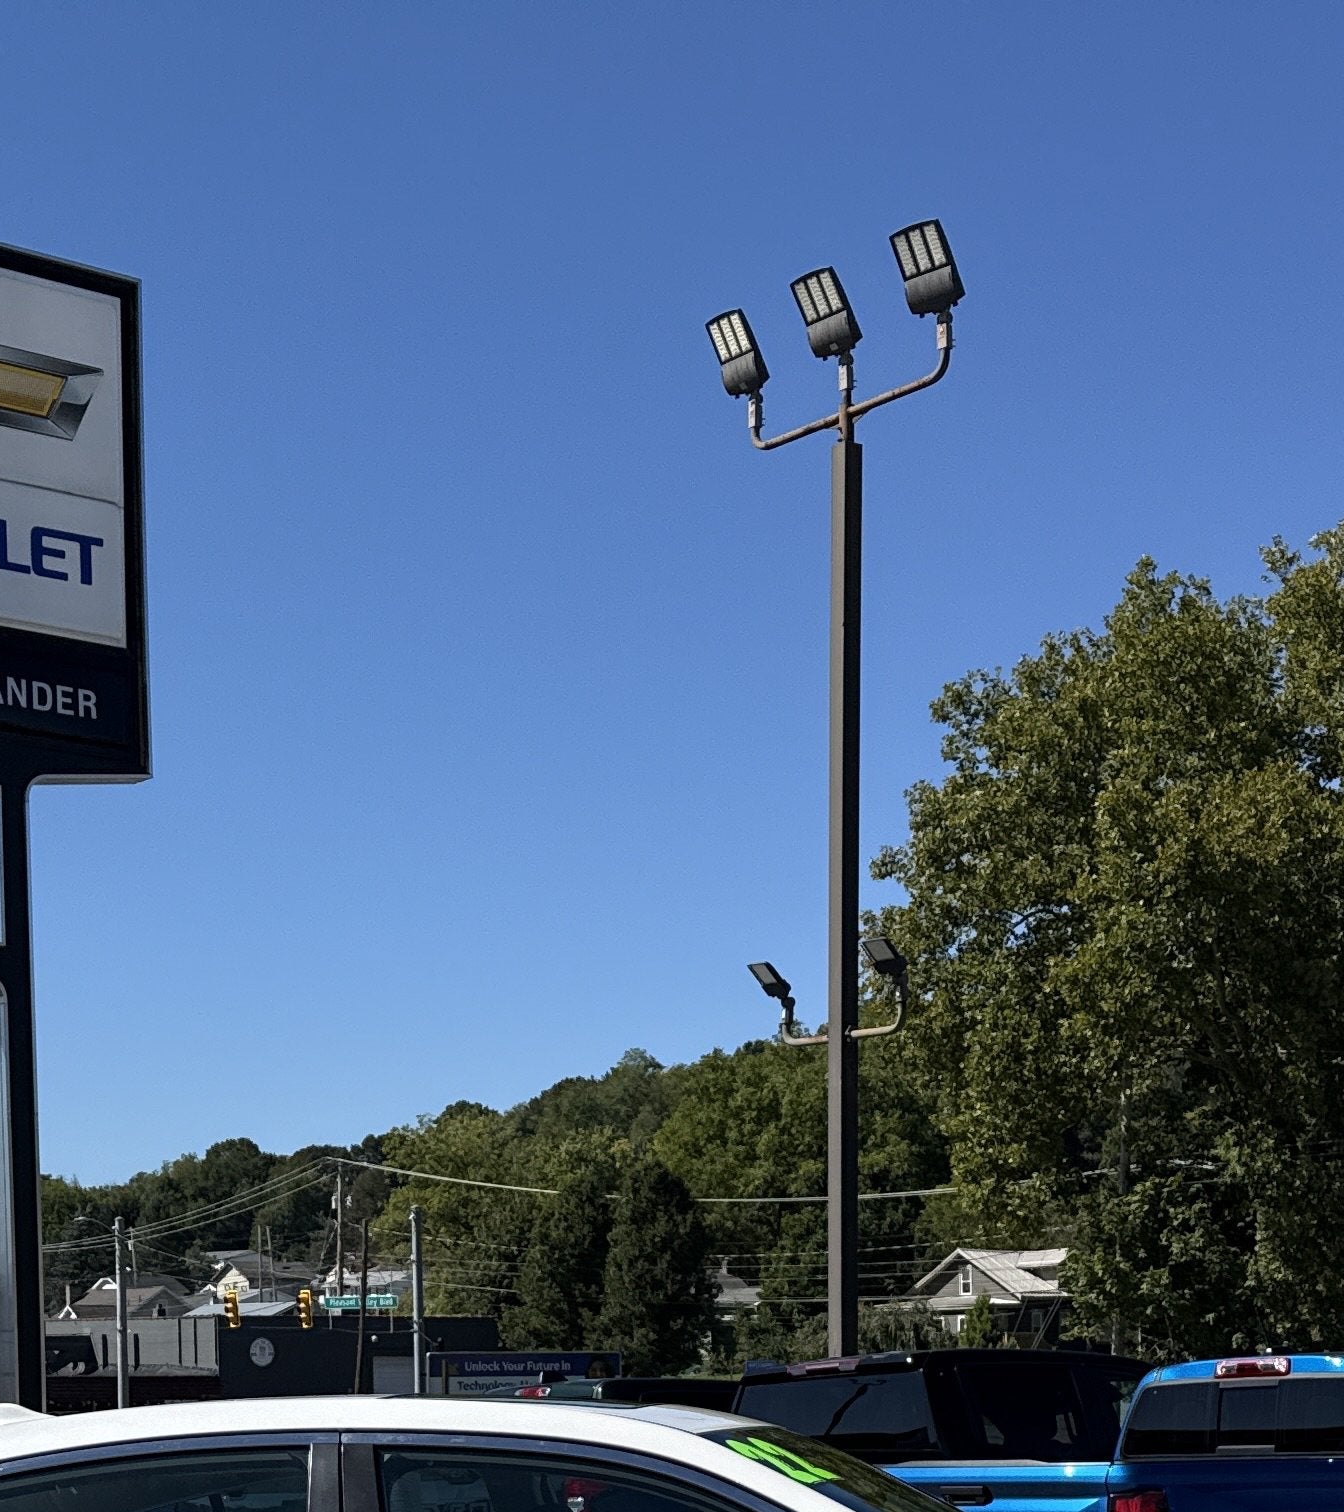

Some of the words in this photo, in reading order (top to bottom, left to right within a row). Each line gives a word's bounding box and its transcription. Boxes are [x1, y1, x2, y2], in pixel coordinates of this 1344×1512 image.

[464, 1361, 500, 1372] Unlock
[502, 1360, 525, 1372] Your
[526, 1360, 560, 1371] Future
[457, 1380, 516, 1393] Technolo
[724, 1436, 845, 1484] 22
